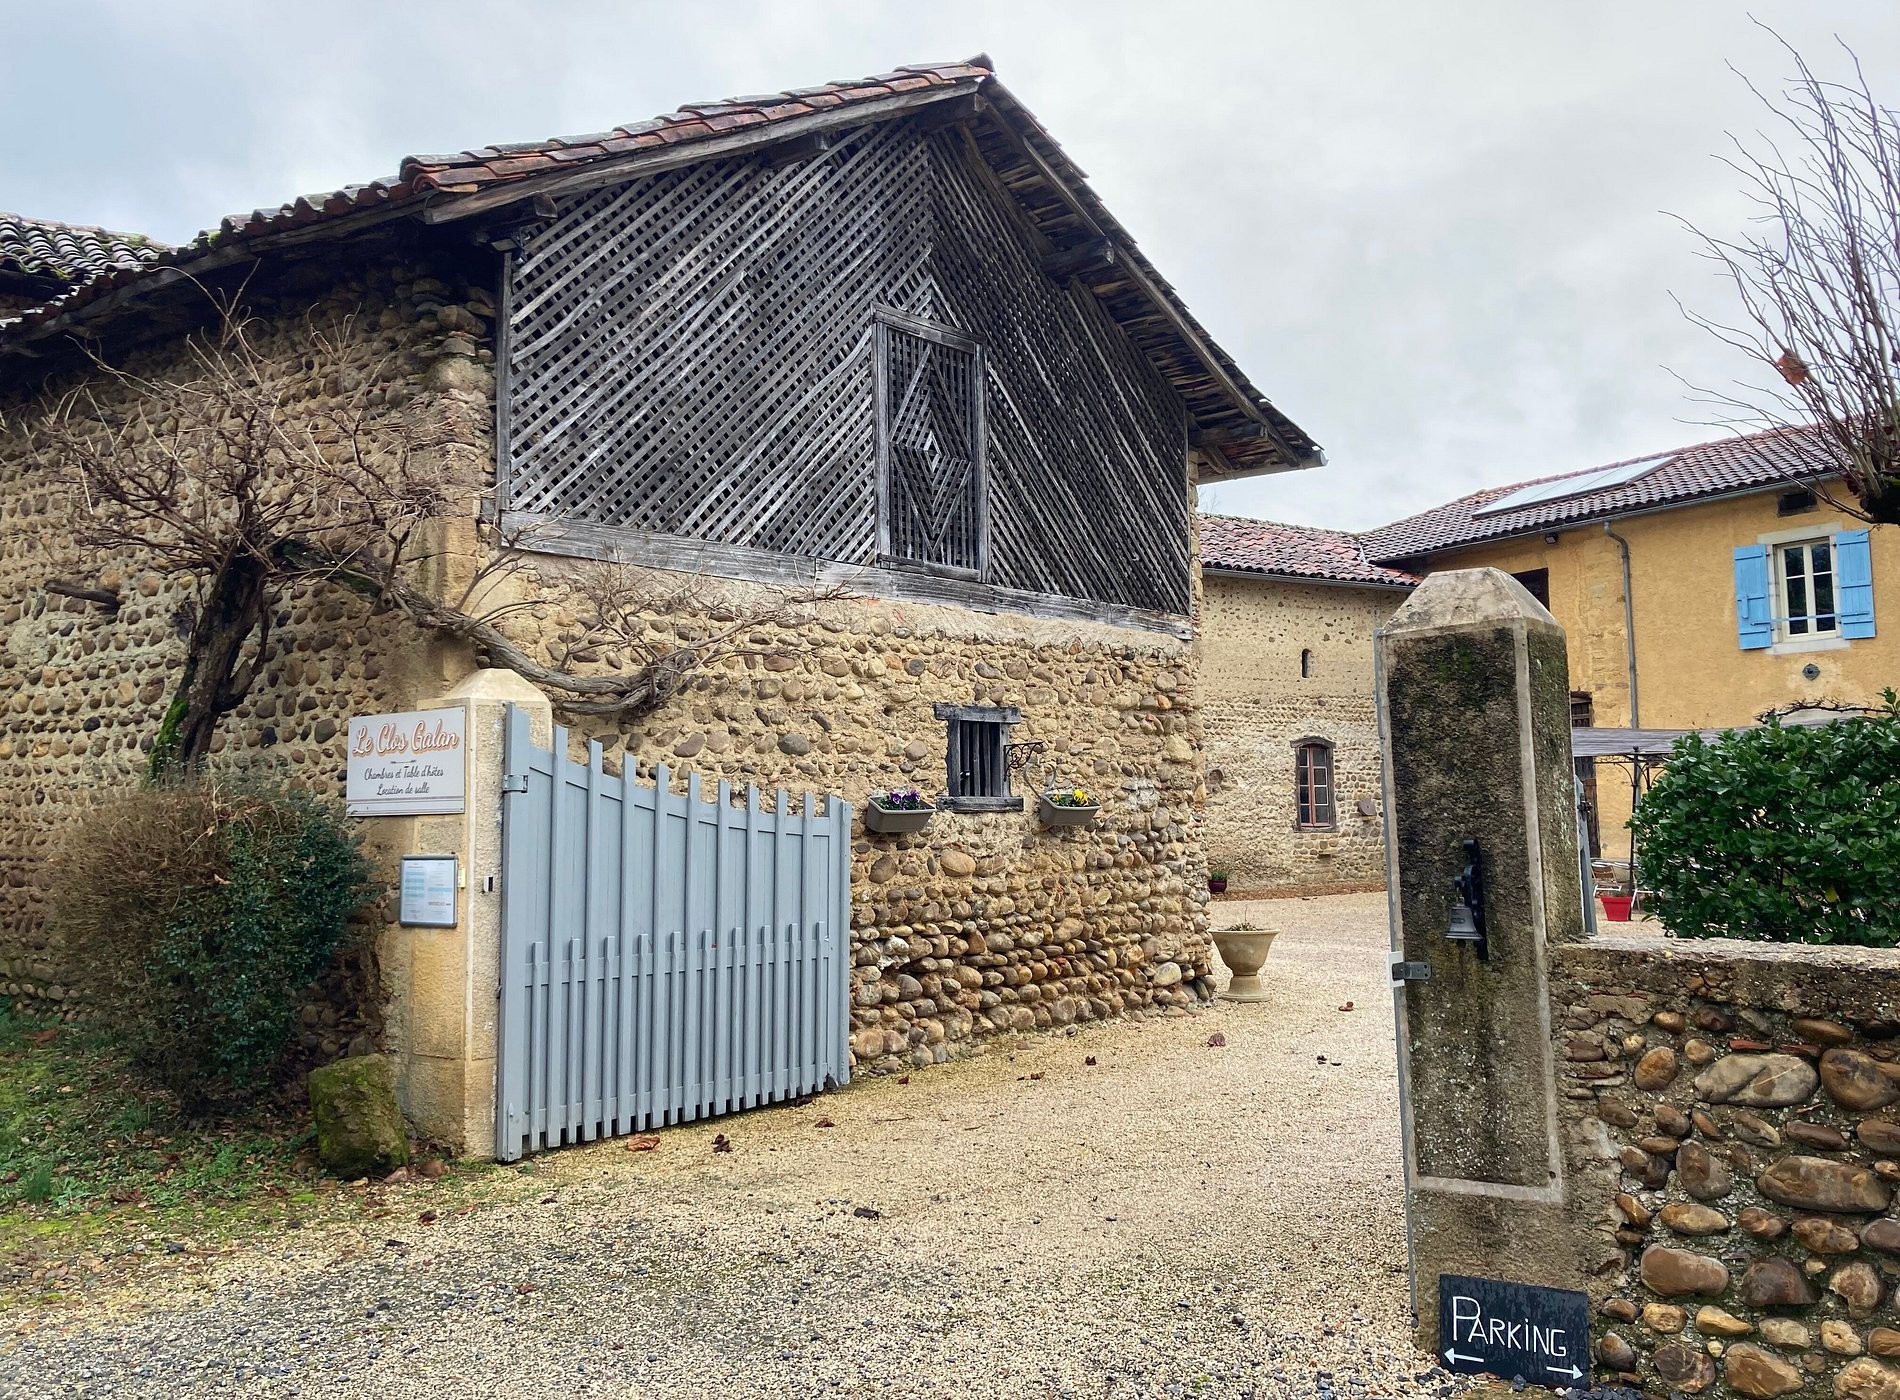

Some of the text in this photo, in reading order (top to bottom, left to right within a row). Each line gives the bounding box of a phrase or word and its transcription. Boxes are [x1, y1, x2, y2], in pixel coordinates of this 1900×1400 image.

[352, 718, 460, 757] Le Clos Galan
[364, 768, 394, 781] Chambres
[395, 769, 402, 778] et
[404, 765, 420, 778] Table
[377, 782, 430, 796] Location de salle
